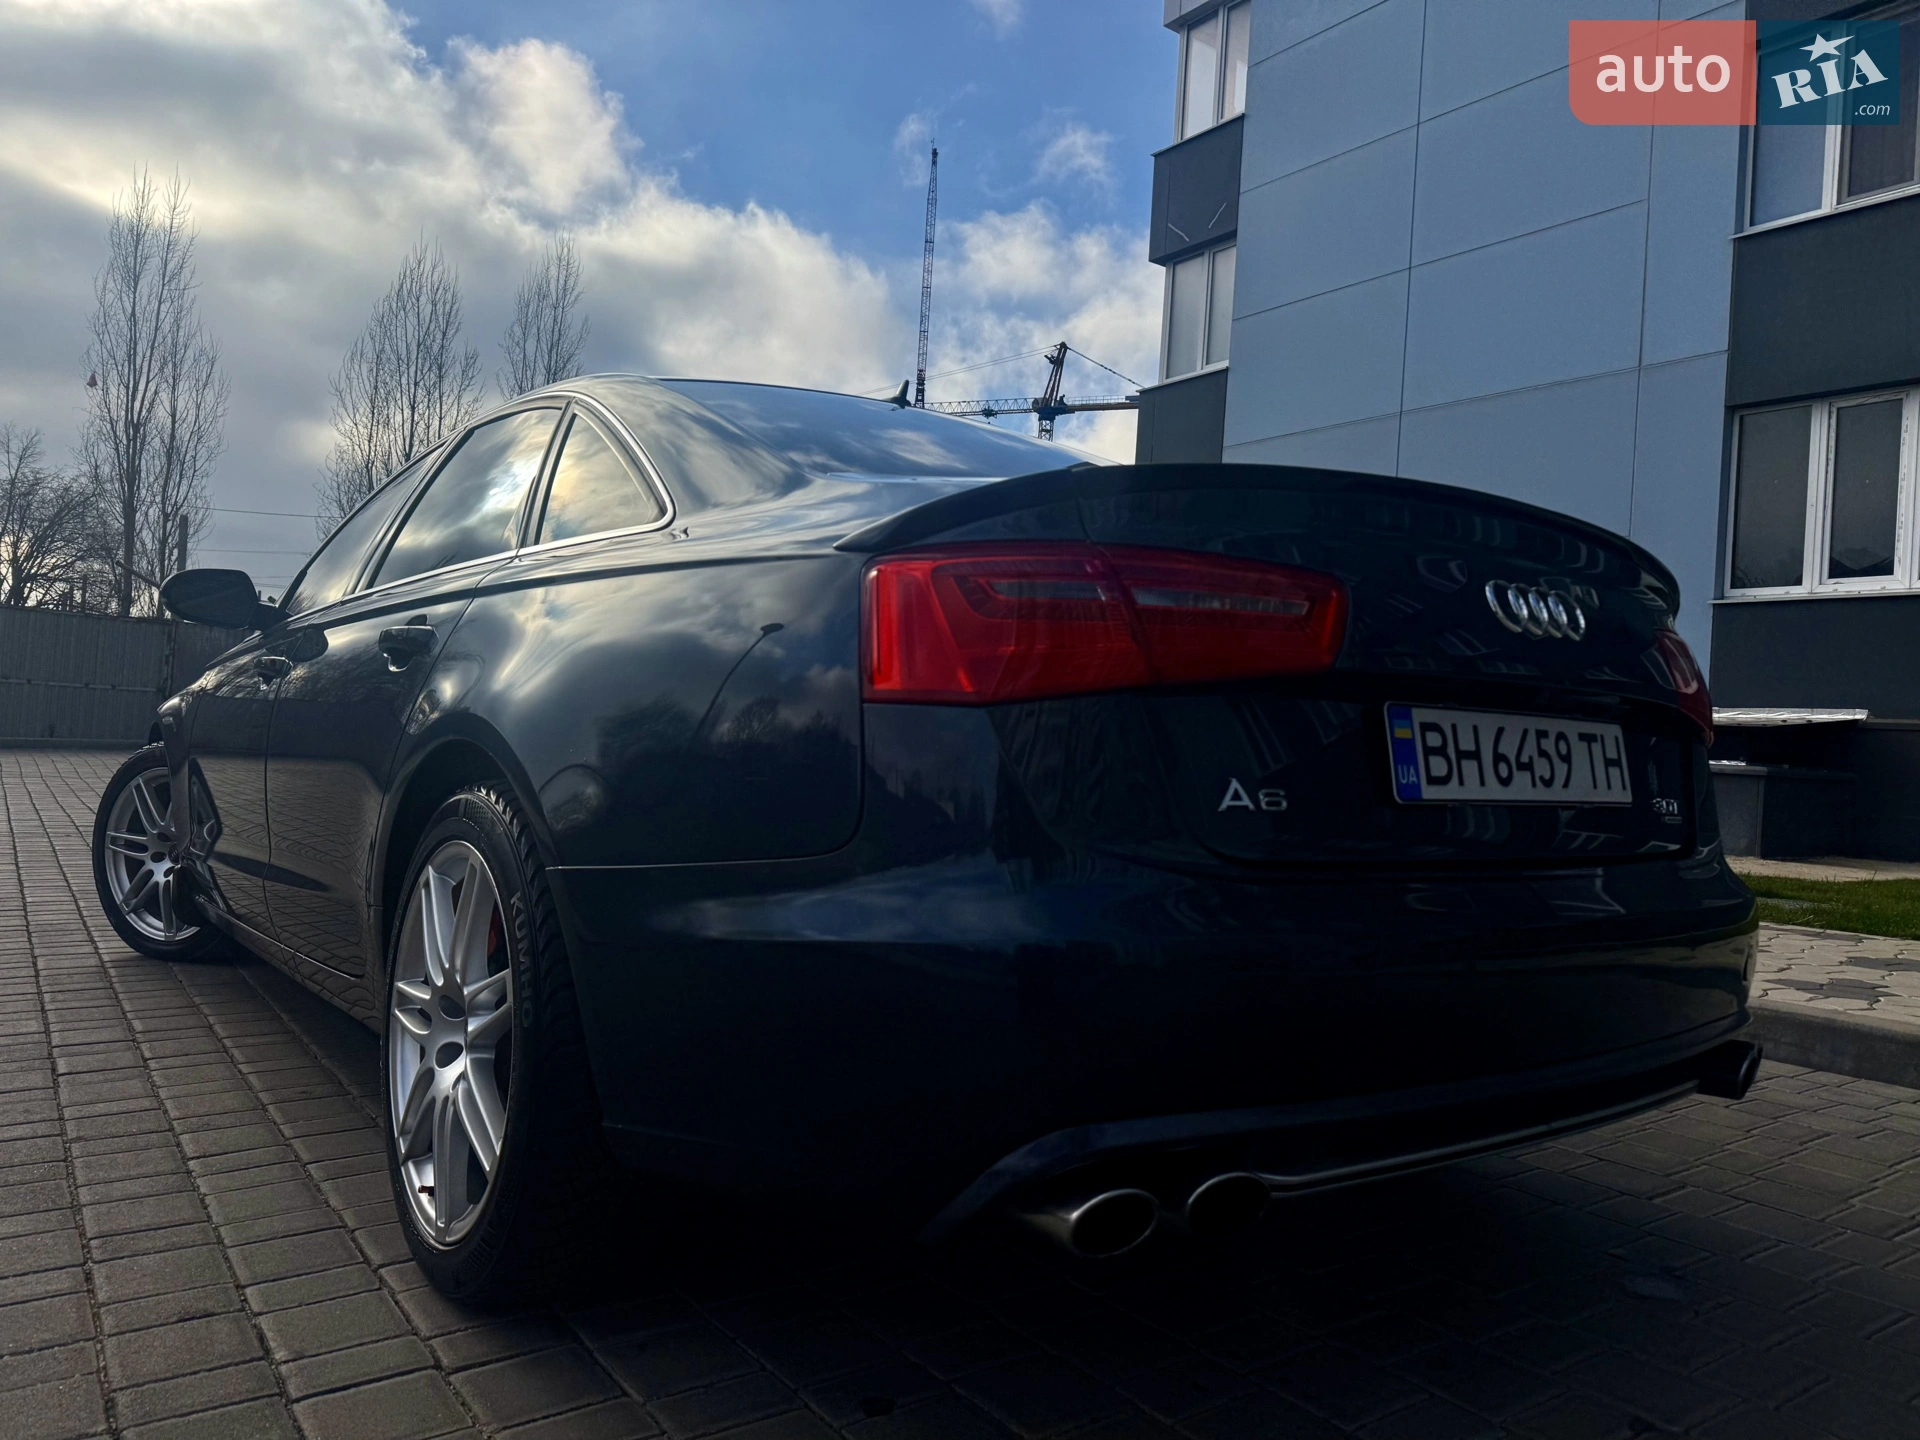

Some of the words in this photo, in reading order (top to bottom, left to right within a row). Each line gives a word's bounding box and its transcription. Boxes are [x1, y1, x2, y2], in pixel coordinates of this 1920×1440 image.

[1398, 763, 1418, 785] UA
[1217, 777, 1288, 811] A6
[510, 889, 533, 1028] KUMHO
